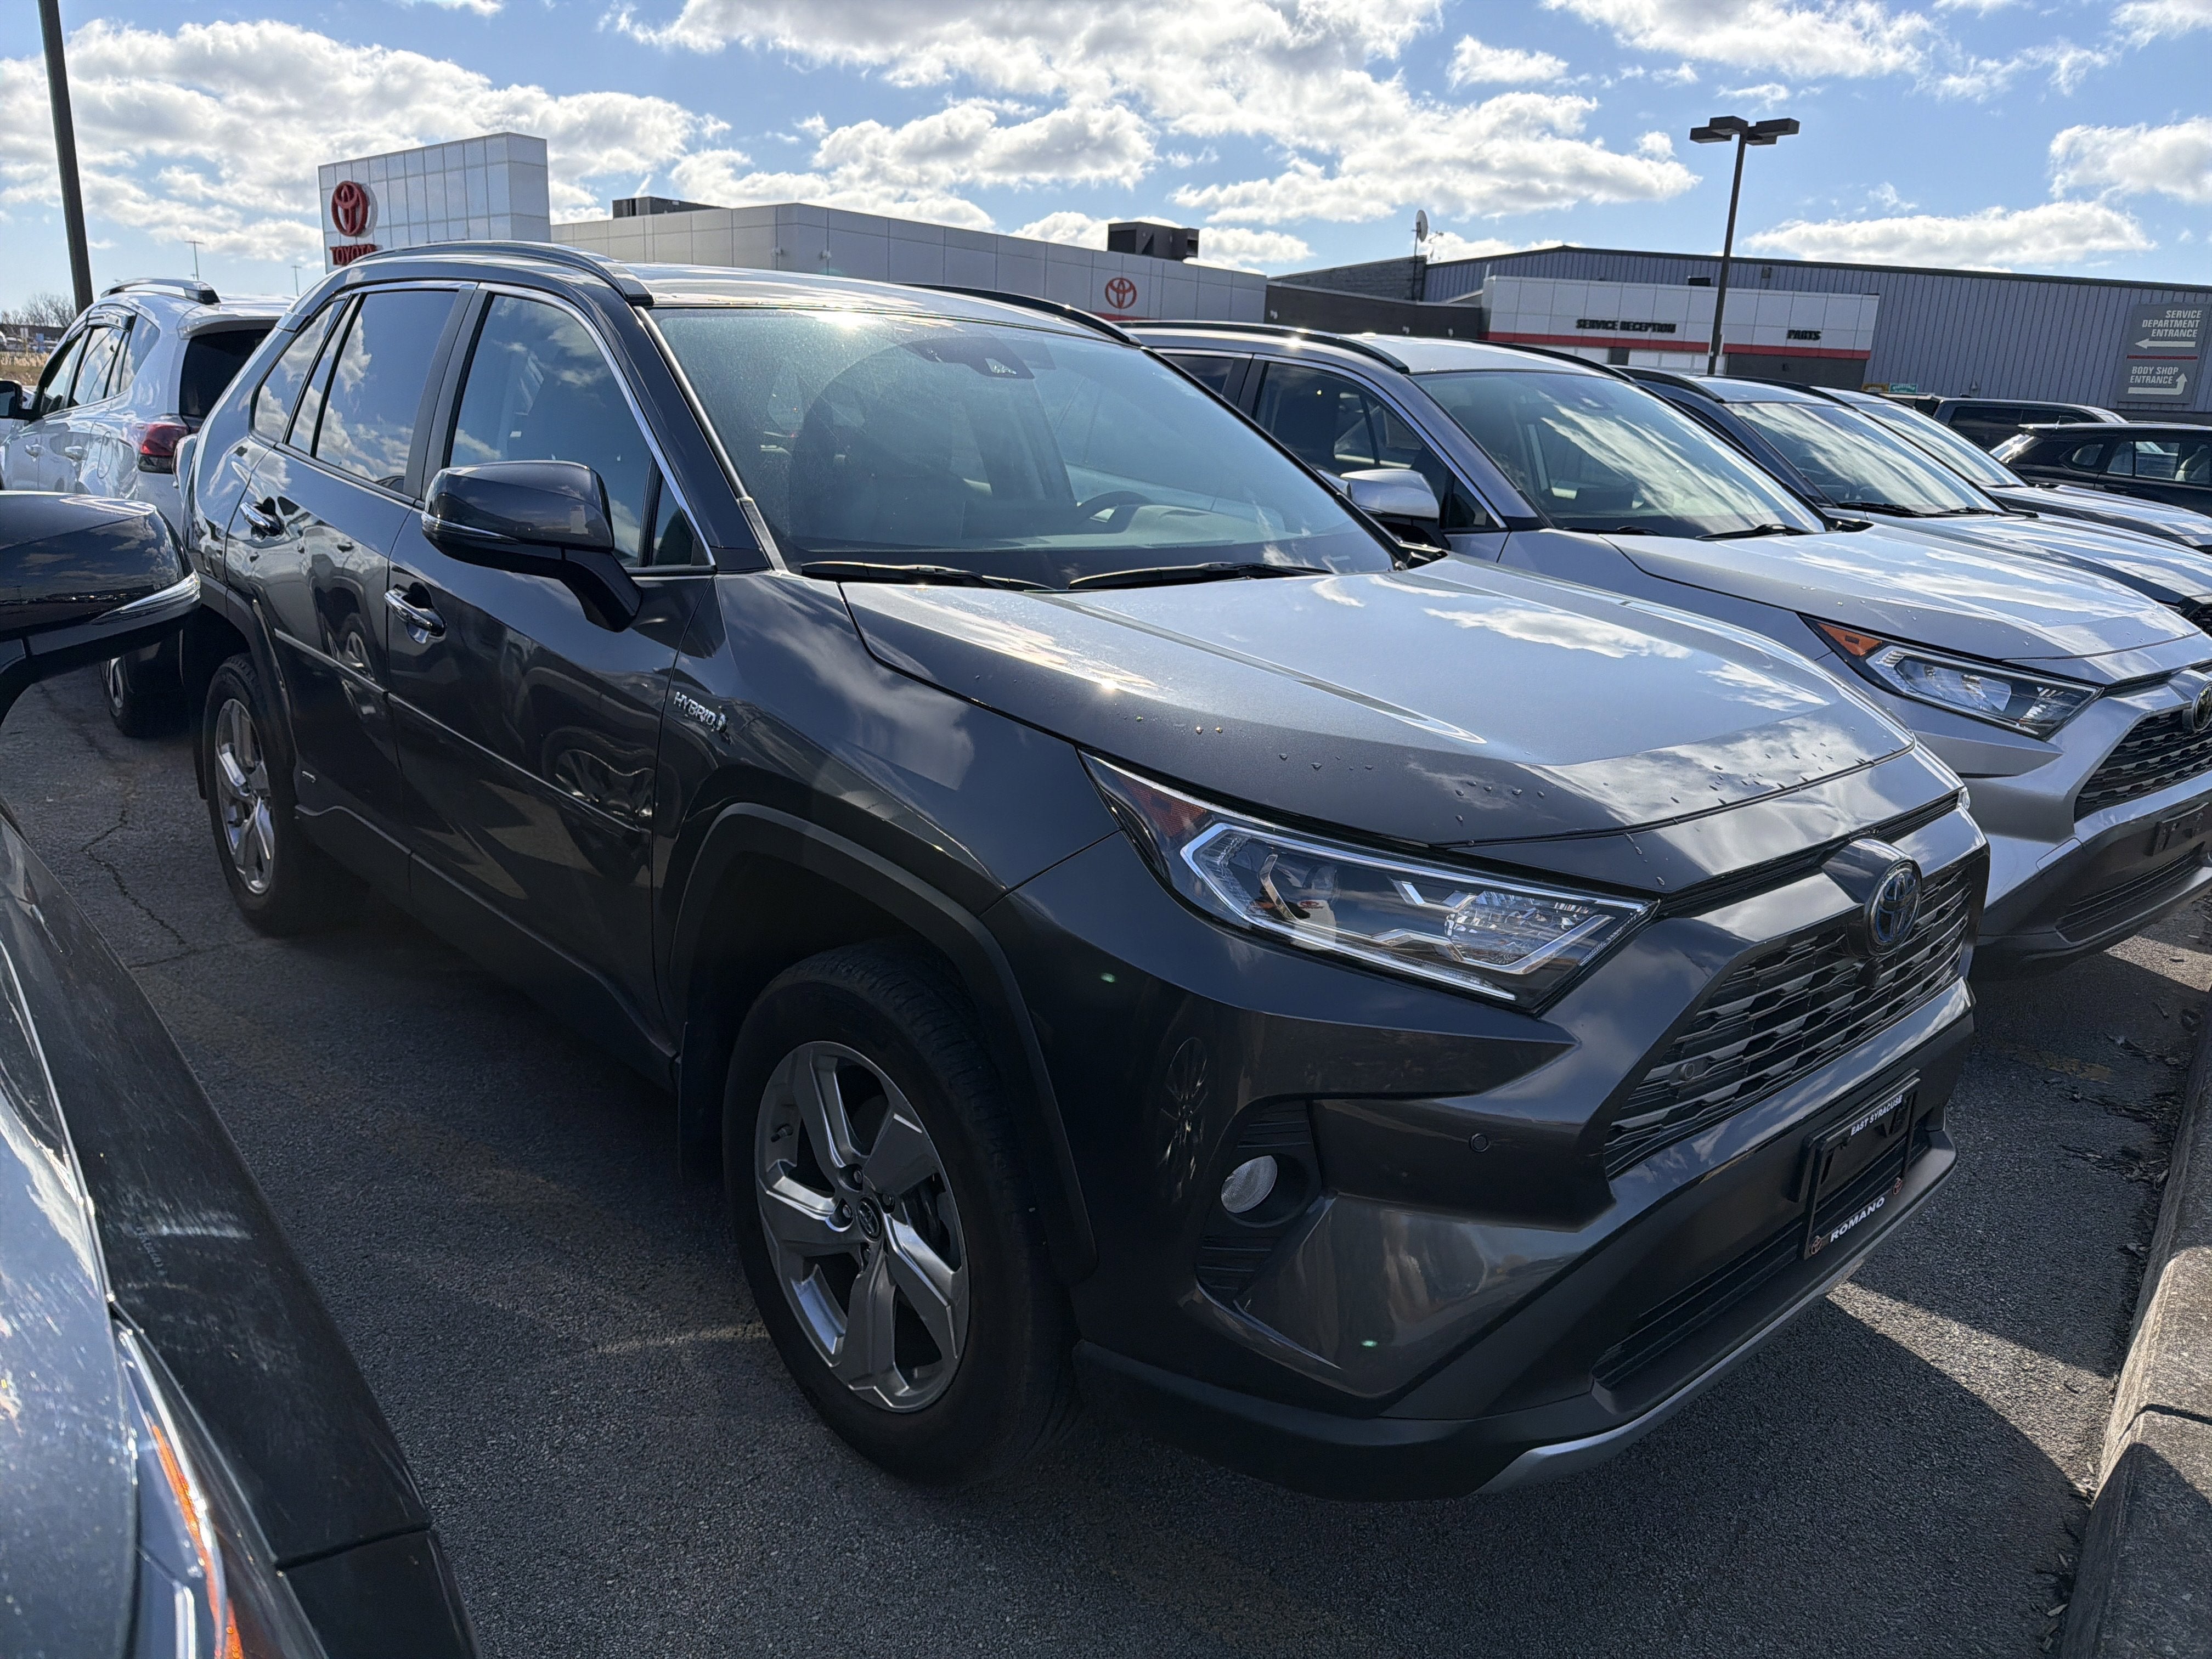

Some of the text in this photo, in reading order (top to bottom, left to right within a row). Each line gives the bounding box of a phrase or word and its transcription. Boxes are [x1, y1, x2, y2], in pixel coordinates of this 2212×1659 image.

[2165, 310, 2202, 319] SERVICE
[1576, 319, 1677, 334] SERVICE RECEPTION
[2142, 319, 2200, 328] DEPARTMENT
[1787, 330, 1821, 341] PARTS
[2151, 329, 2198, 337] ENTRANCE
[2131, 366, 2179, 375] BODY SHOP
[2130, 375, 2173, 384] ENTRANCE
[673, 691, 716, 725] HYBRID
[1850, 1094, 1903, 1136] EAST SYRACUSE
[1830, 1197, 1885, 1243] ROMANO
